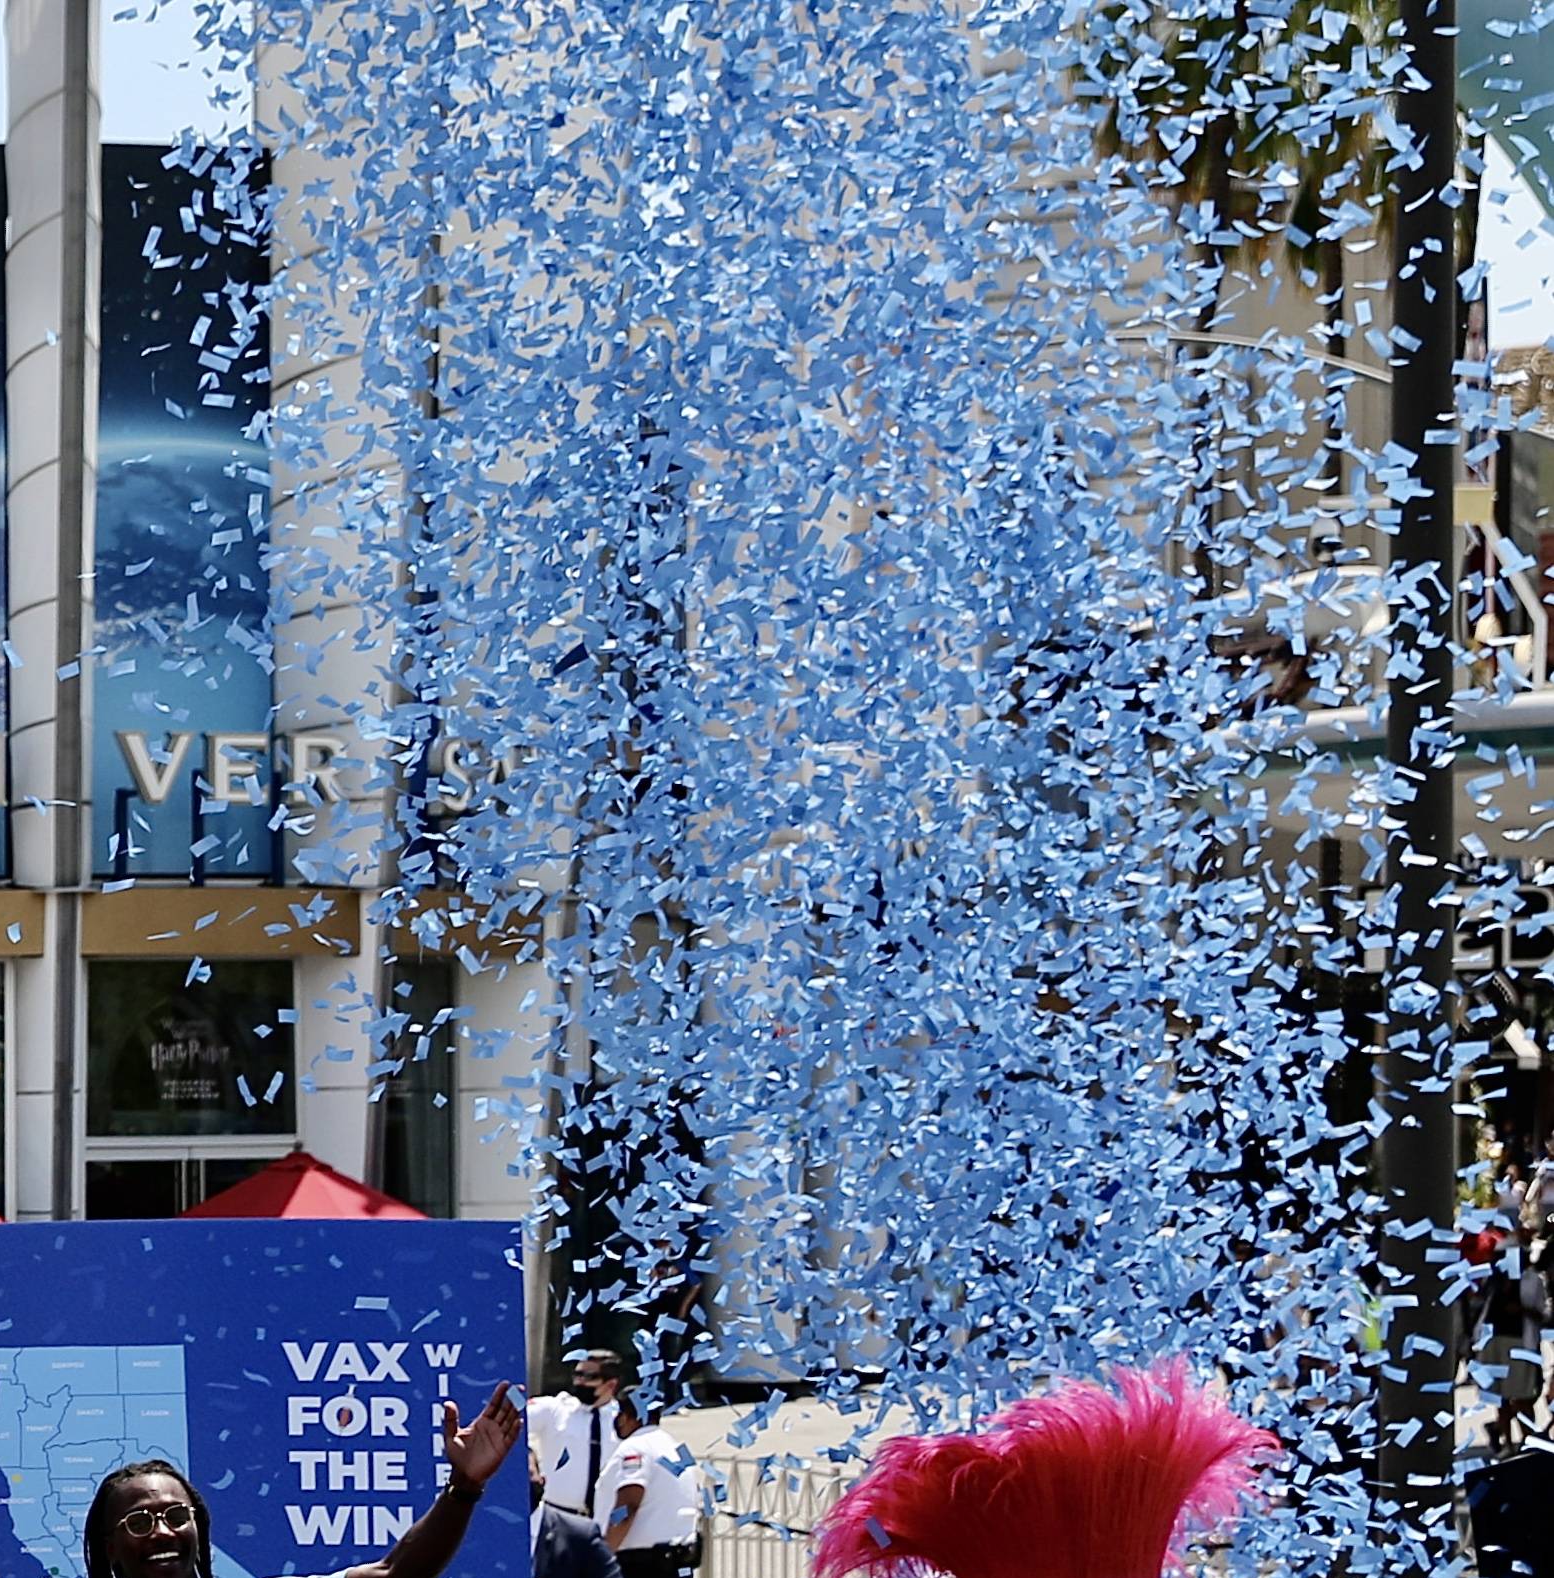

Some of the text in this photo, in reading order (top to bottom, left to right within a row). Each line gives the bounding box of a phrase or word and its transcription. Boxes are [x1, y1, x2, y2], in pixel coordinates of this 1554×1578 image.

[281, 1342, 411, 1382] VAX
[287, 1394, 410, 1437] FOR
[288, 1451, 408, 1491] THE
[284, 1505, 414, 1546] WIN
